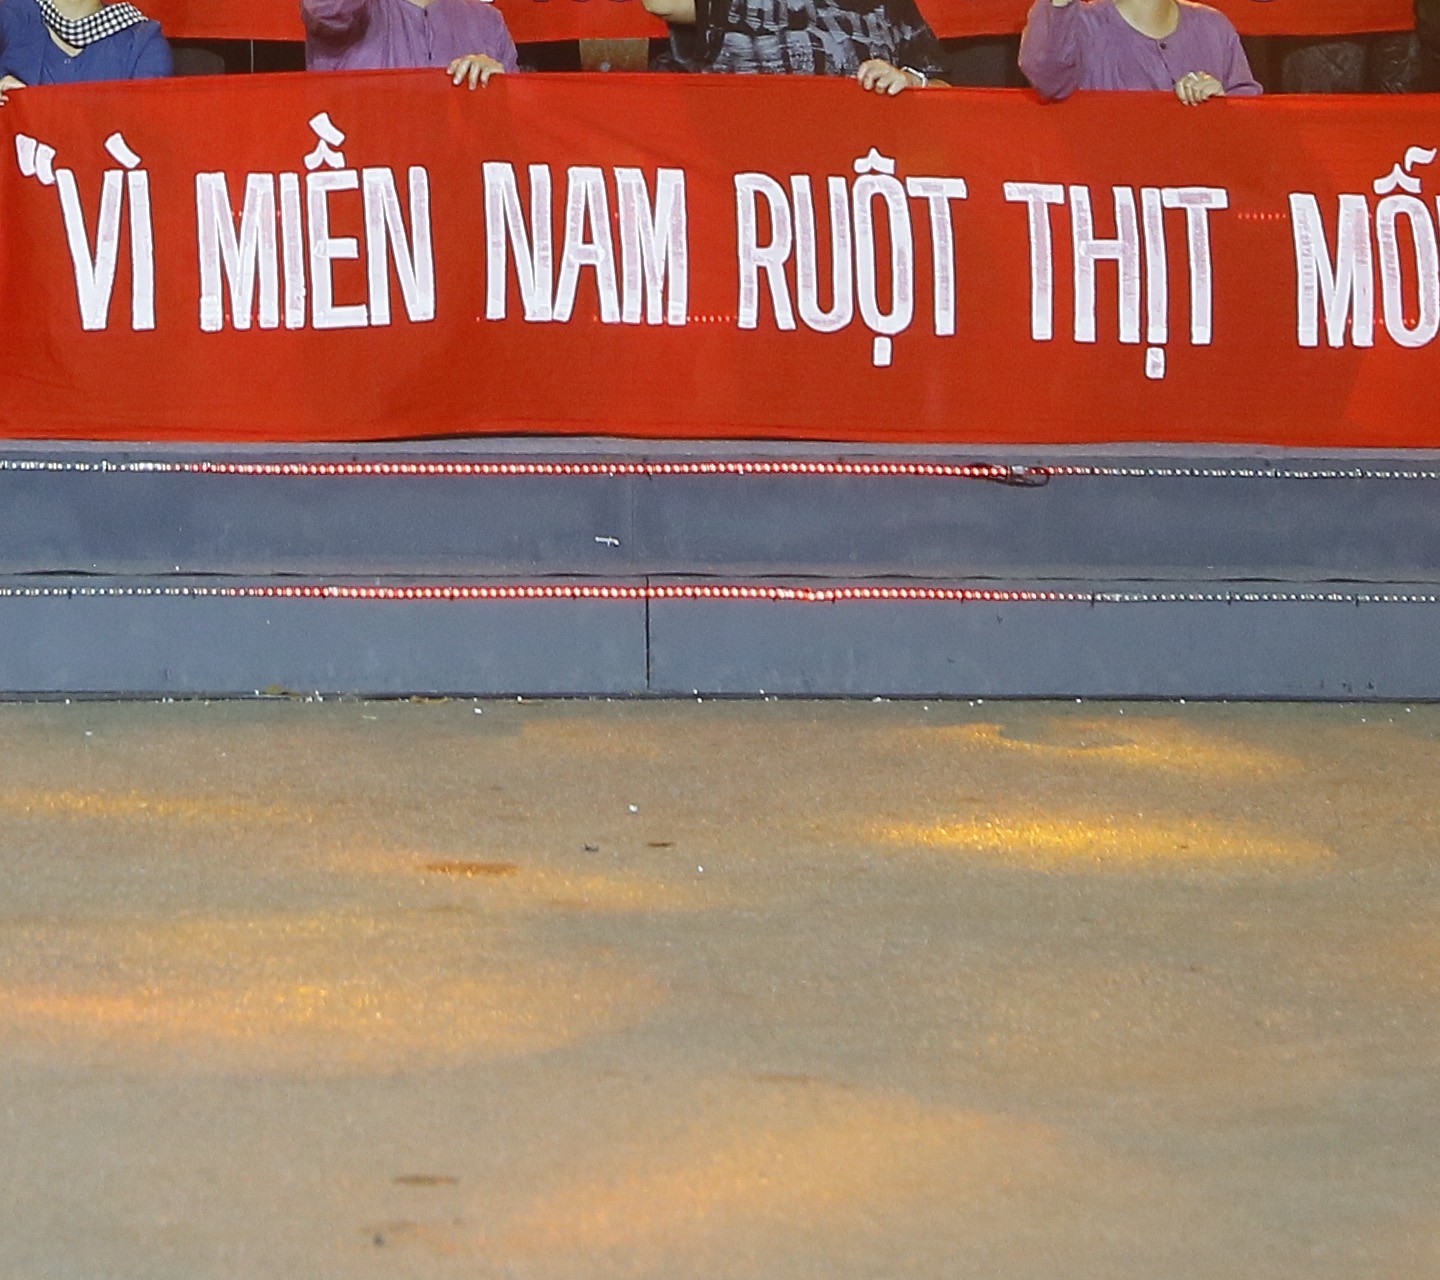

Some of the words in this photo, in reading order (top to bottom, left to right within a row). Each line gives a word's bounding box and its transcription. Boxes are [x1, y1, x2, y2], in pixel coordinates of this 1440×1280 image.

[194, 112, 437, 332] MIỀN
[480, 160, 688, 327] NAM
[733, 146, 968, 368] RUỘT
[1002, 182, 1230, 380] THỊT
